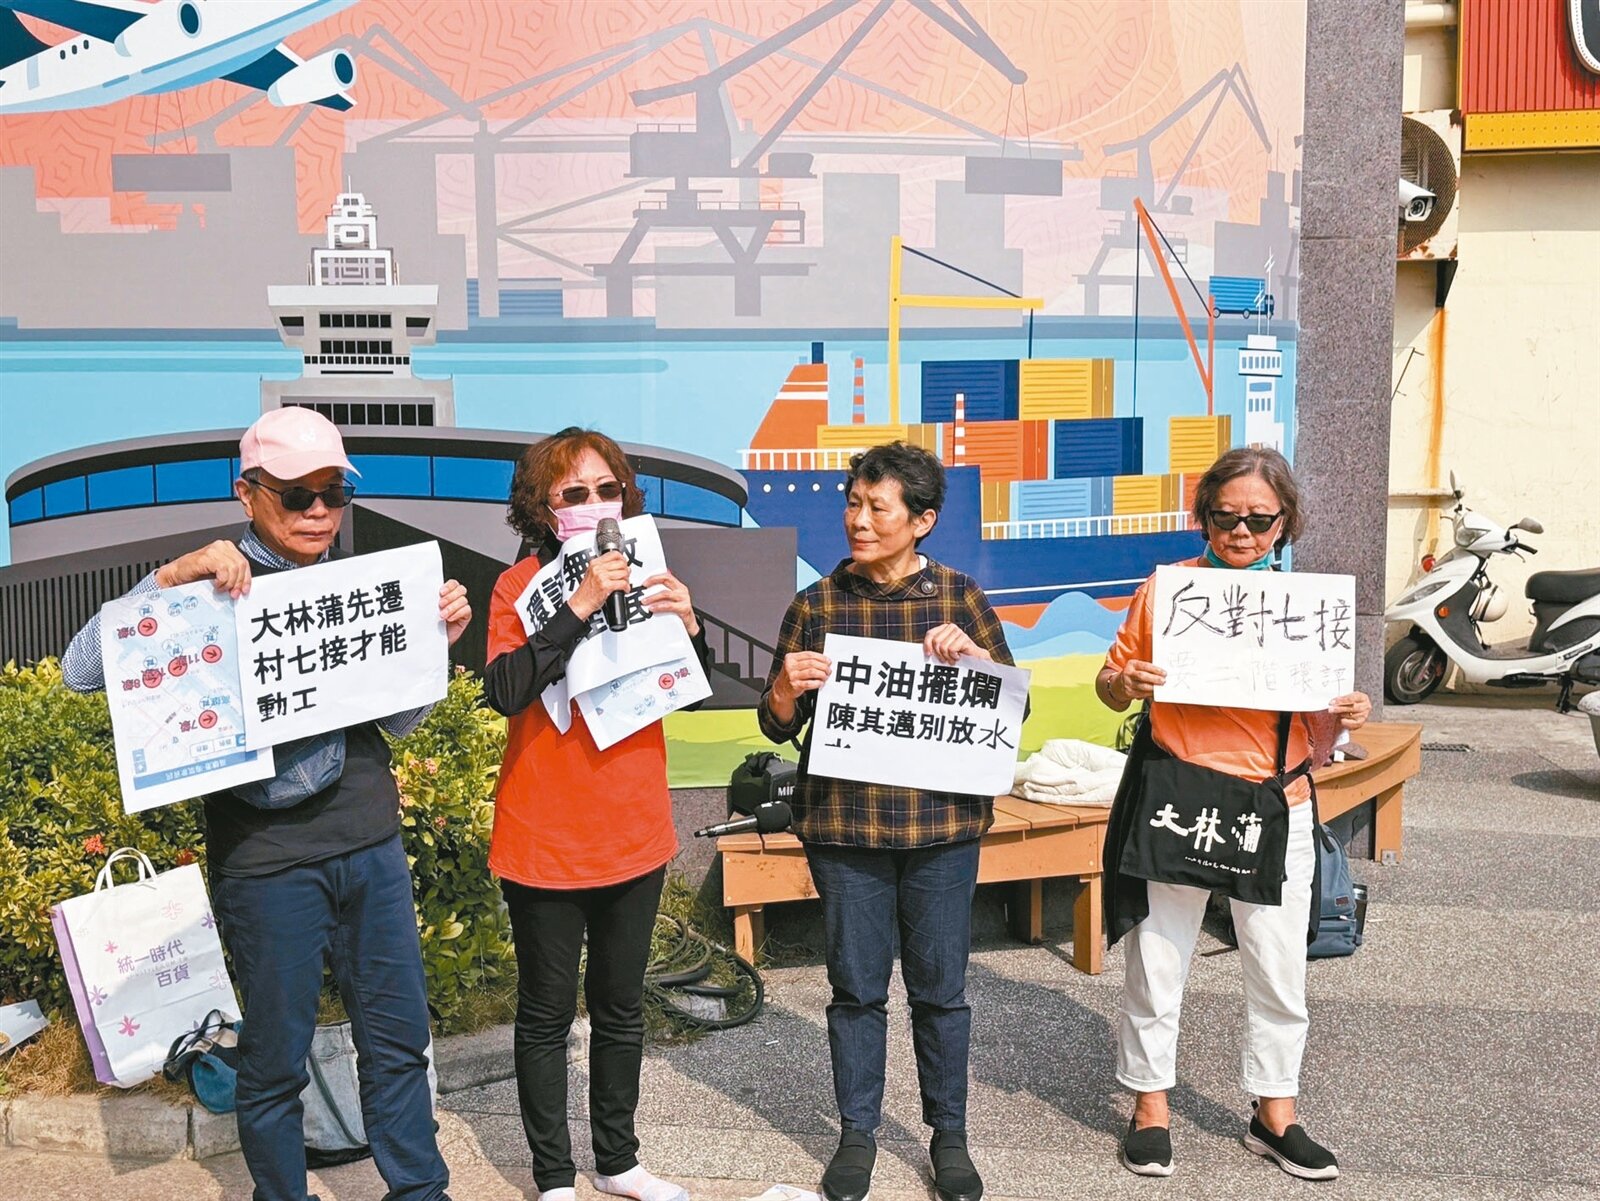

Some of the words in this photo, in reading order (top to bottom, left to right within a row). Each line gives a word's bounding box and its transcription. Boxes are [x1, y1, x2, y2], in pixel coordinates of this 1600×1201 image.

[251, 580, 404, 643] 大林蒲先遷
[1163, 581, 1351, 651] 反對七接
[254, 622, 407, 684] 村七接才能
[257, 686, 317, 723] 動工
[835, 656, 1002, 710] 中油擺爛
[826, 702, 1014, 750] 陳其邁別放水
[1150, 803, 1262, 853] 大林蒲
[117, 939, 185, 974] 統一時代
[155, 963, 191, 988] 百貨
